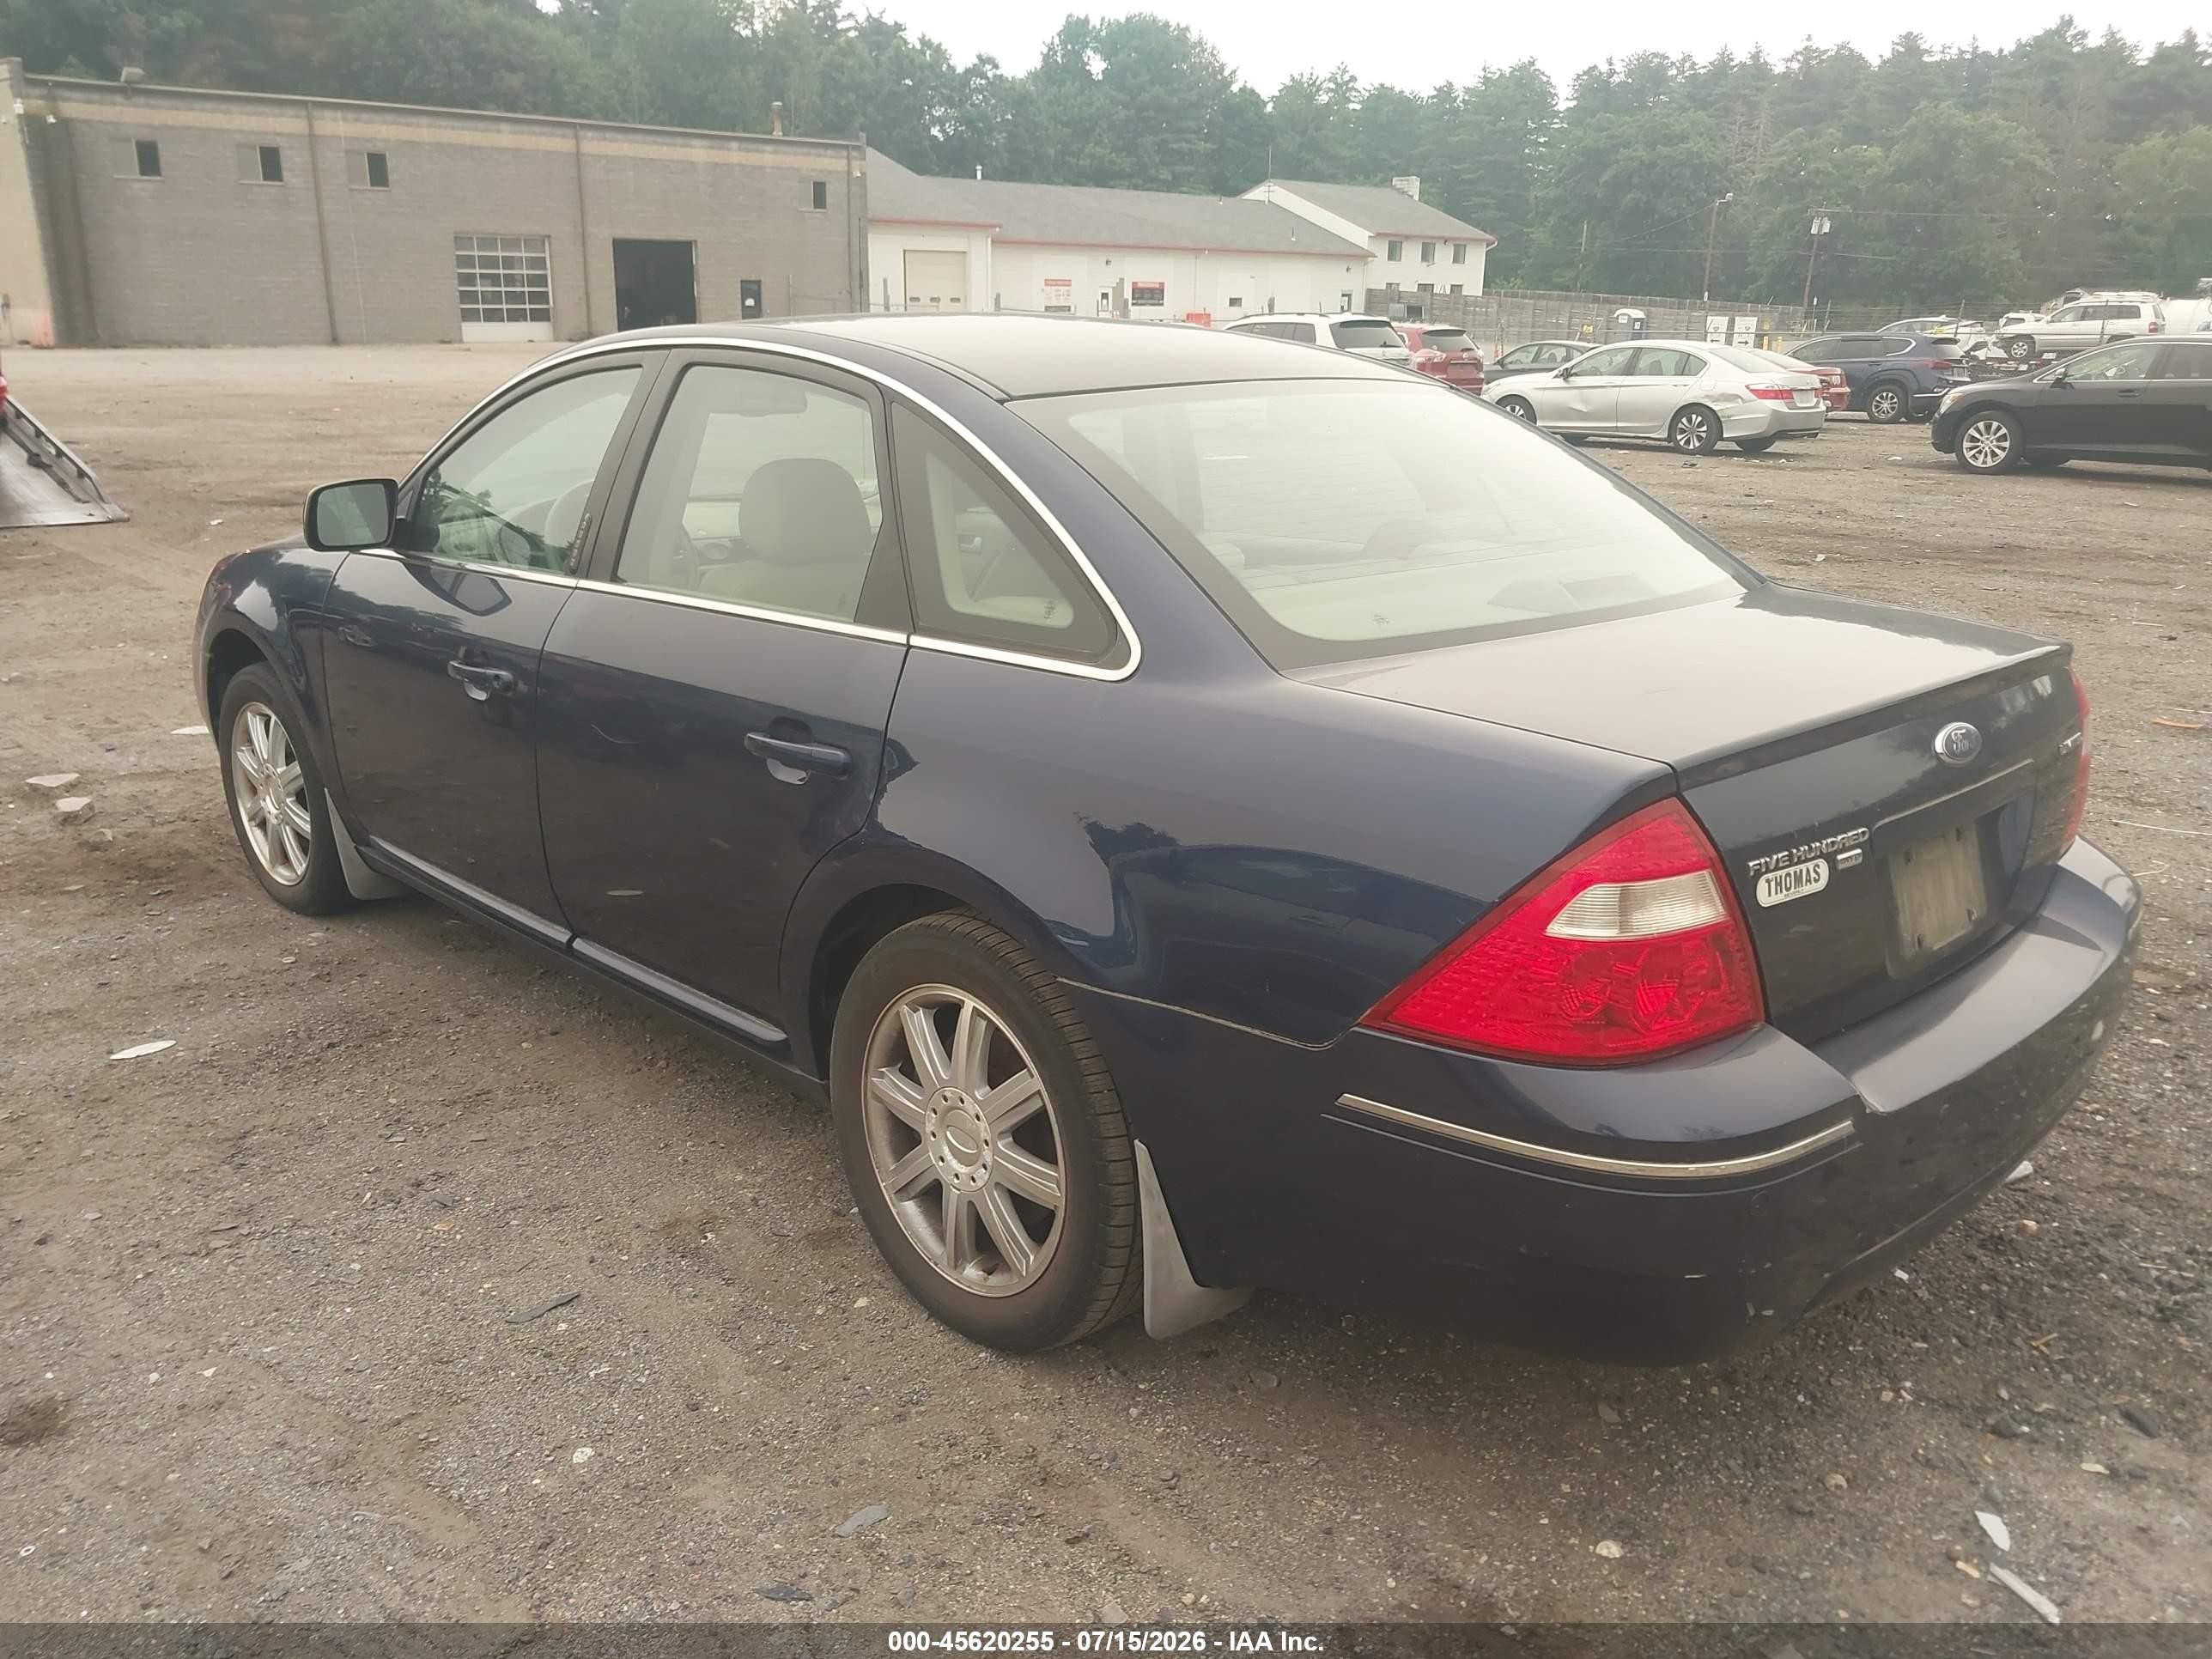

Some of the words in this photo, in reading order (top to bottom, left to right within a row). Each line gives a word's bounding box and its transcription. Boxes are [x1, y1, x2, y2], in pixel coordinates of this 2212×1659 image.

[1747, 851, 1790, 876] FIVE
[1791, 827, 1870, 863] HUNDRED
[1765, 863, 1821, 898] THOMAS
